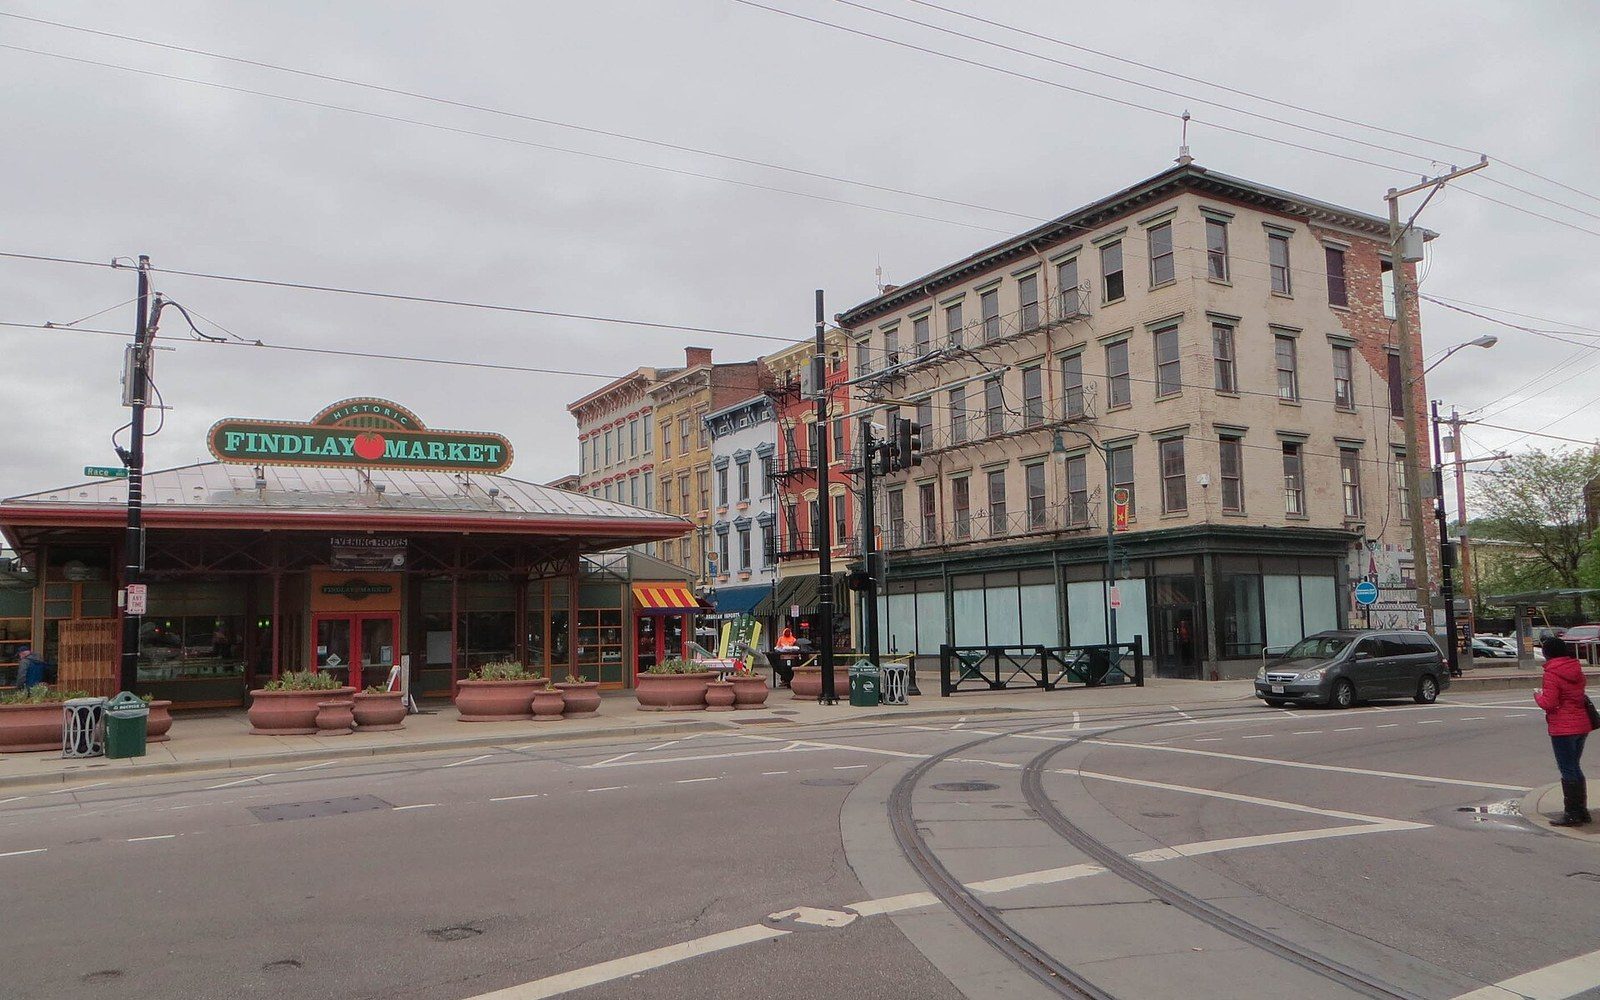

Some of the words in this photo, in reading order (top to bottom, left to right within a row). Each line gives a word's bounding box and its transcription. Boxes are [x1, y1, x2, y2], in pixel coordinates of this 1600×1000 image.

[333, 405, 408, 425] HISTORIC
[224, 431, 357, 455] FINDLAY
[384, 439, 501, 463] MARKET
[87, 467, 109, 476] Race
[331, 537, 374, 547] EVENING
[375, 538, 408, 547] HOURS
